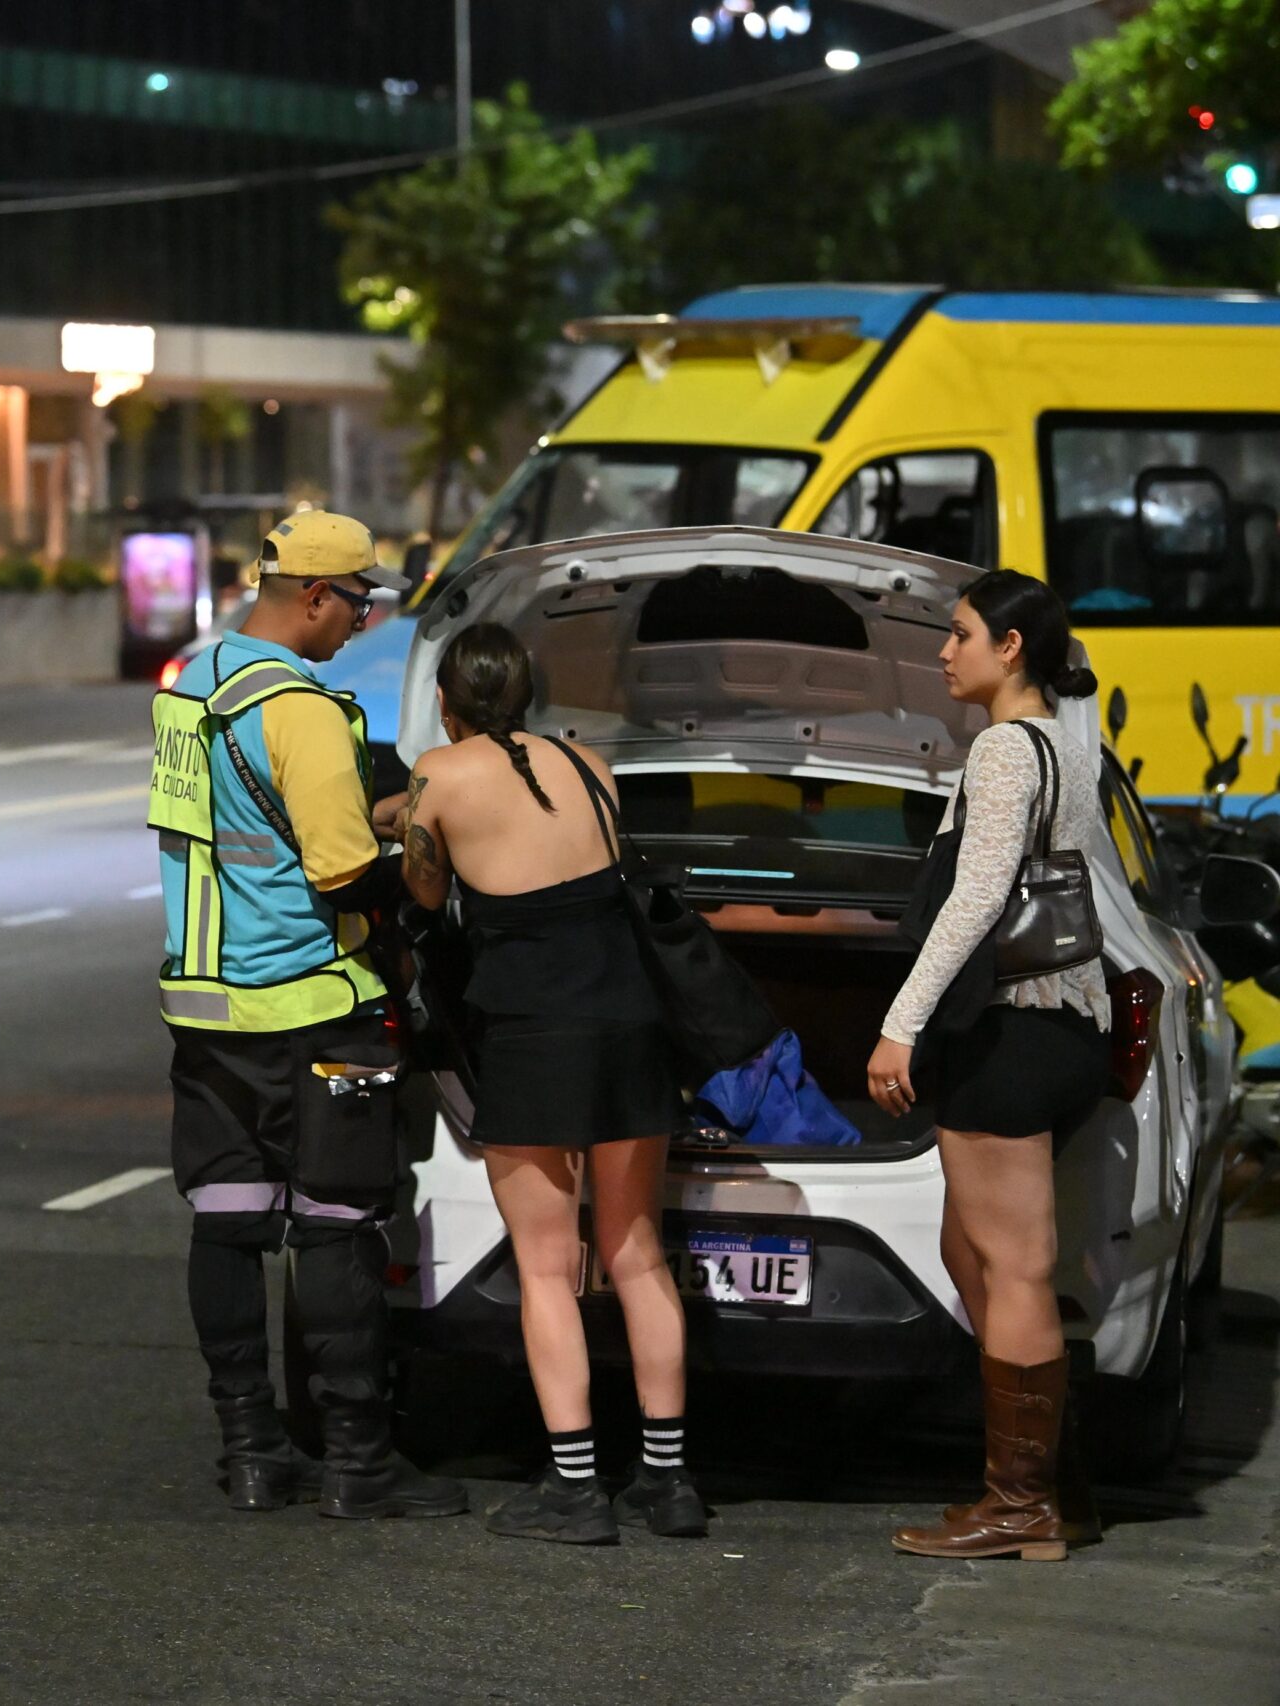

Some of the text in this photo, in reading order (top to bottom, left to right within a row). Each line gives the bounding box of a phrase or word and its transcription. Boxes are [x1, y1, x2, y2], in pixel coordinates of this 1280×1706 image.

[230, 746, 245, 769] PINK
[241, 769, 258, 791] PINK
[254, 790, 273, 812] PINK
[702, 1241, 752, 1252] ARGENTINA
[751, 1256, 799, 1295] UE
